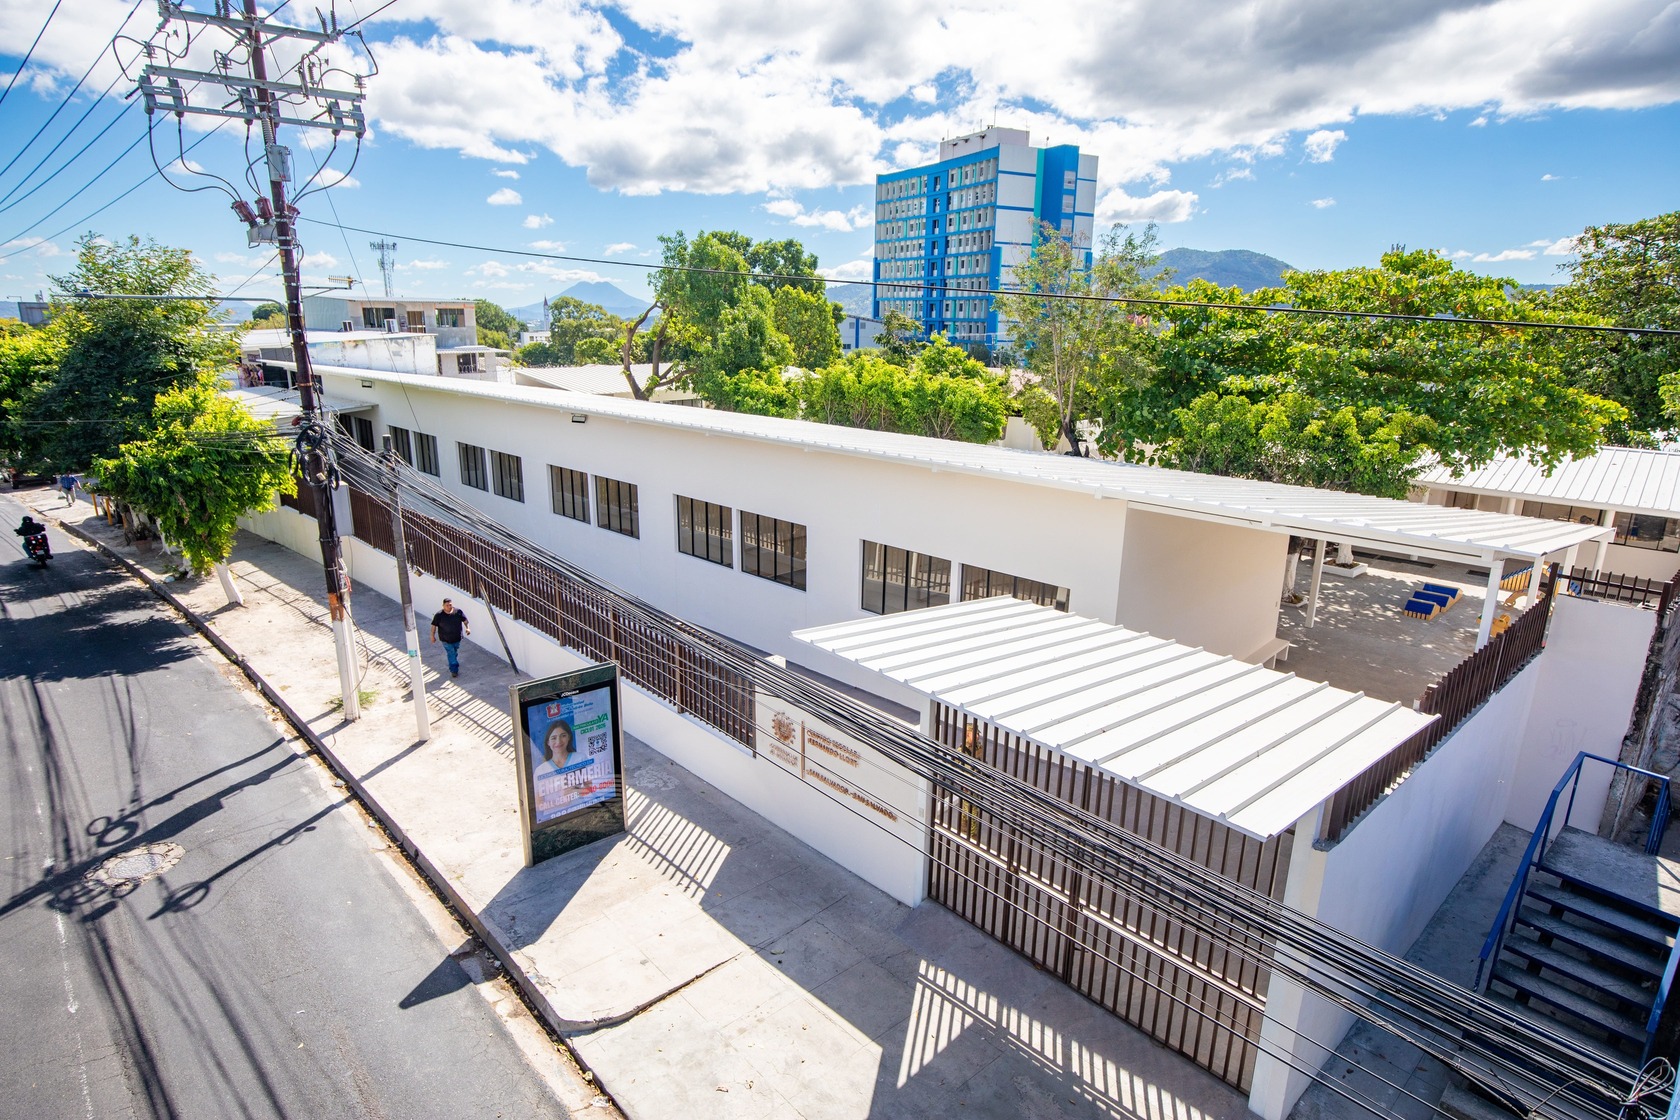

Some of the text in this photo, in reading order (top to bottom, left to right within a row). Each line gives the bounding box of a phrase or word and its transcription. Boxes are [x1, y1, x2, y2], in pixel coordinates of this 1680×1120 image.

[597, 713, 609, 724] YA
[807, 738, 838, 757] FERNANDO
[539, 799, 555, 811] CALL
[555, 791, 580, 806] CENTER:
